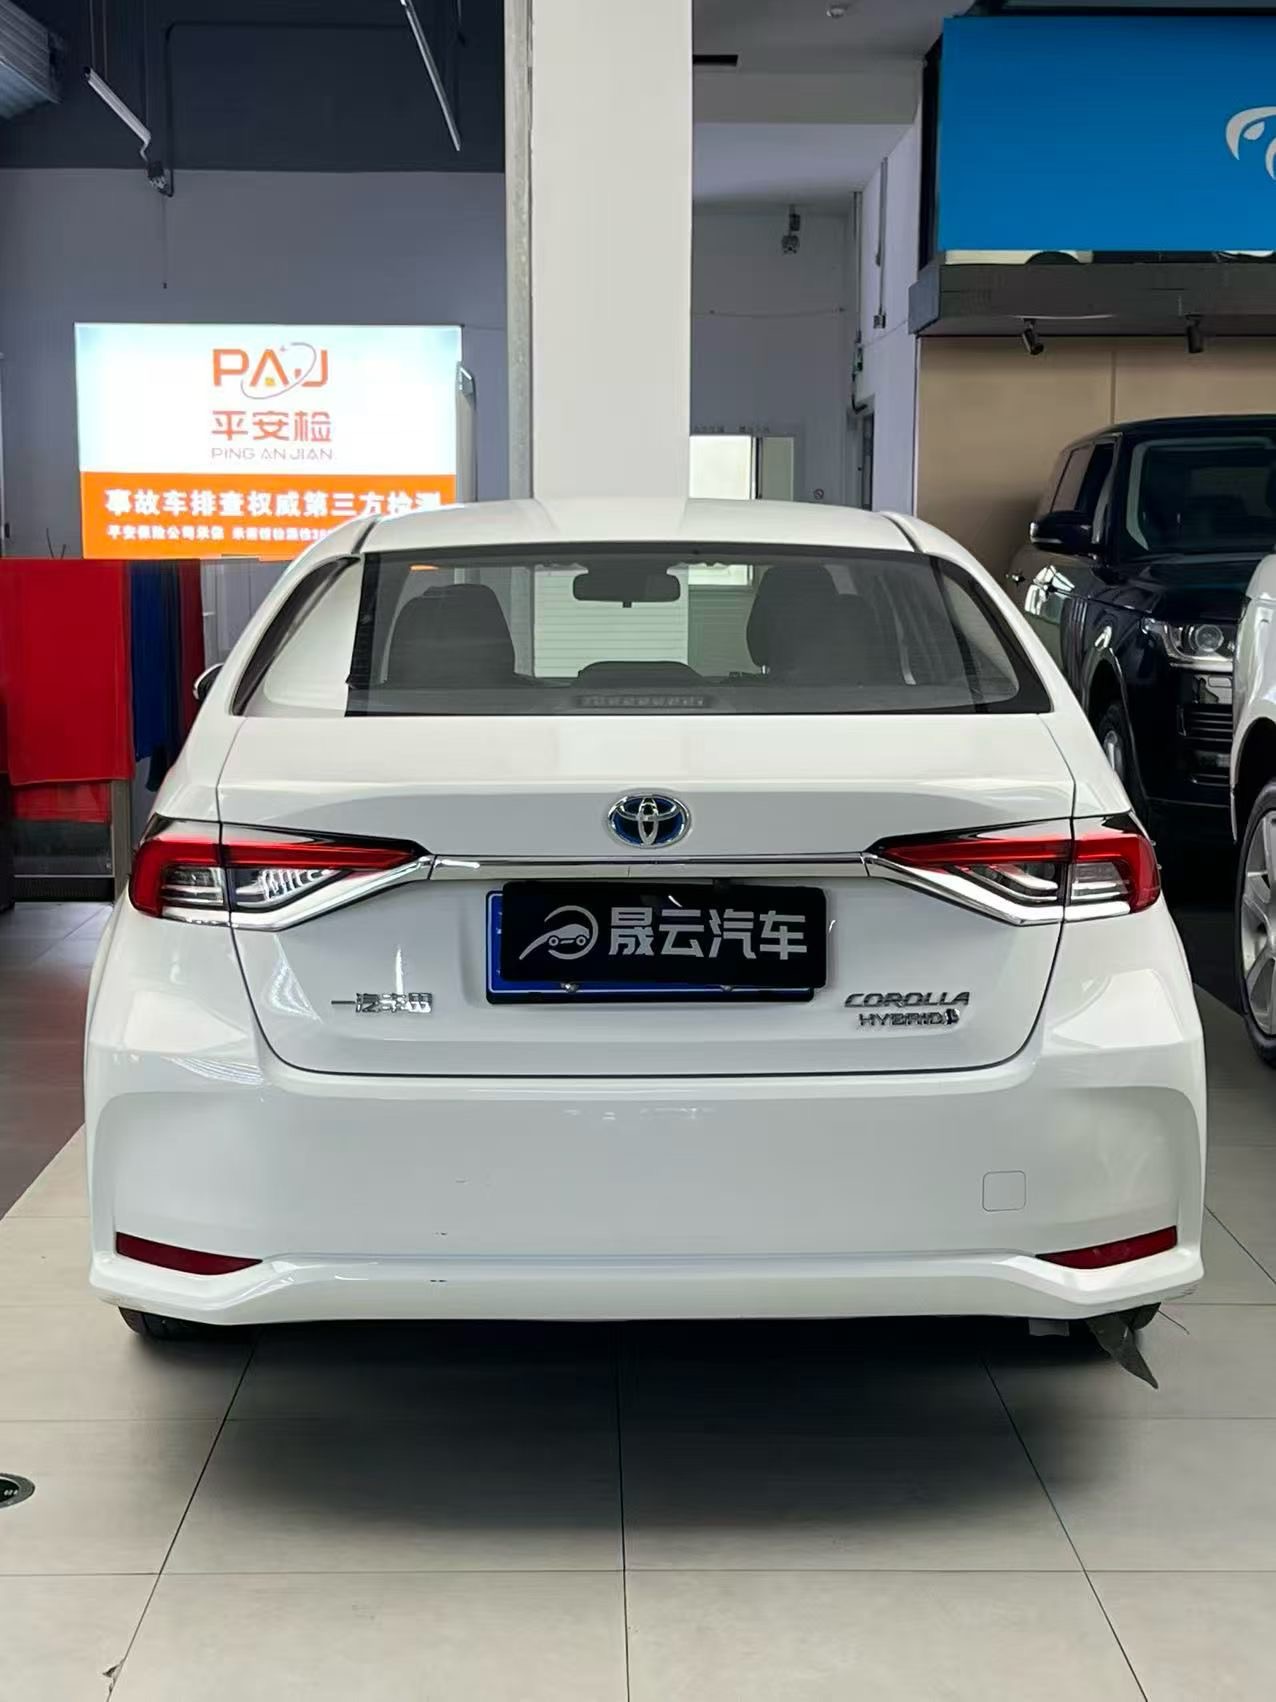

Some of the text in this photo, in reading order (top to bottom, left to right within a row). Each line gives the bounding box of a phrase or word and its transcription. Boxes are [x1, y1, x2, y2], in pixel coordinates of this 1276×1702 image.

[211, 410, 332, 443] 平安检
[211, 447, 333, 460] PING AN JIAN
[608, 906, 807, 960] 晟云汽车
[844, 991, 970, 1008] COROLLA
[859, 1012, 944, 1026] HYBRID
